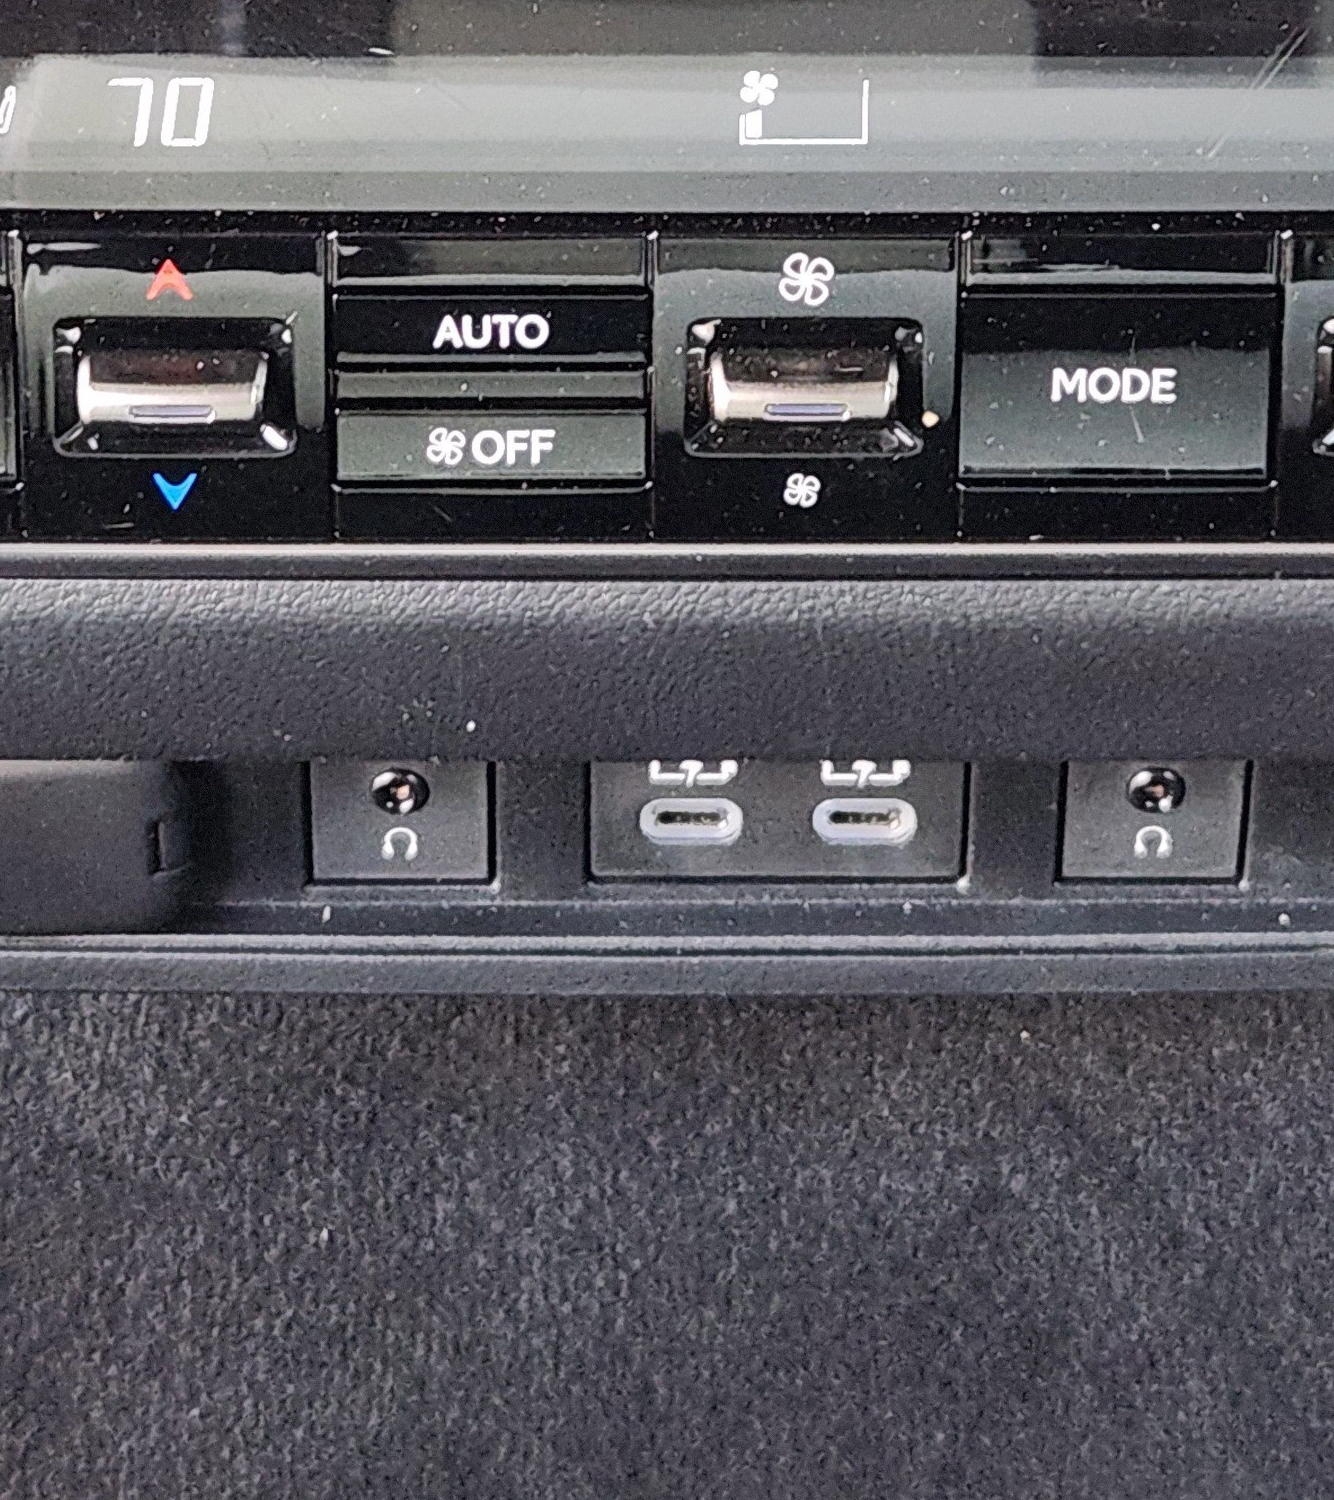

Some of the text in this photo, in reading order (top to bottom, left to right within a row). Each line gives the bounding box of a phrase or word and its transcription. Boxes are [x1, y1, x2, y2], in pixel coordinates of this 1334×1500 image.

[107, 76, 216, 148] 70
[432, 313, 551, 351] AUTO
[1050, 366, 1178, 405] MODE
[471, 427, 556, 467] OFF
